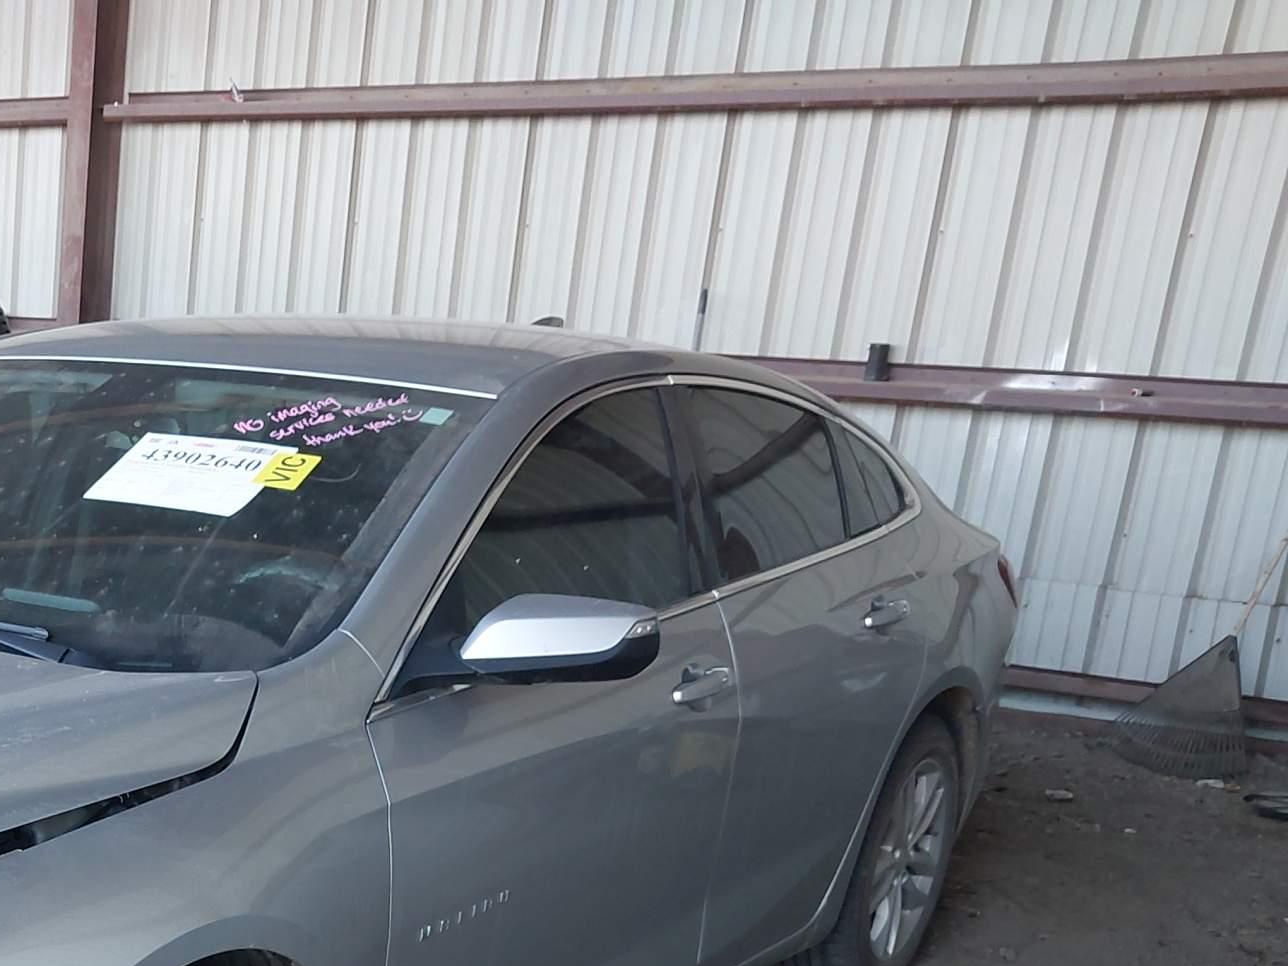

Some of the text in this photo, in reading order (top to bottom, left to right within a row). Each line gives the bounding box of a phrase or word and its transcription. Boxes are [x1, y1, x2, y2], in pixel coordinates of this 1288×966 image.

[266, 396, 342, 423] imaging
[269, 392, 409, 440] services needed
[302, 424, 364, 447] thank
[141, 448, 263, 472] 43902640
[264, 455, 307, 483] VIC
